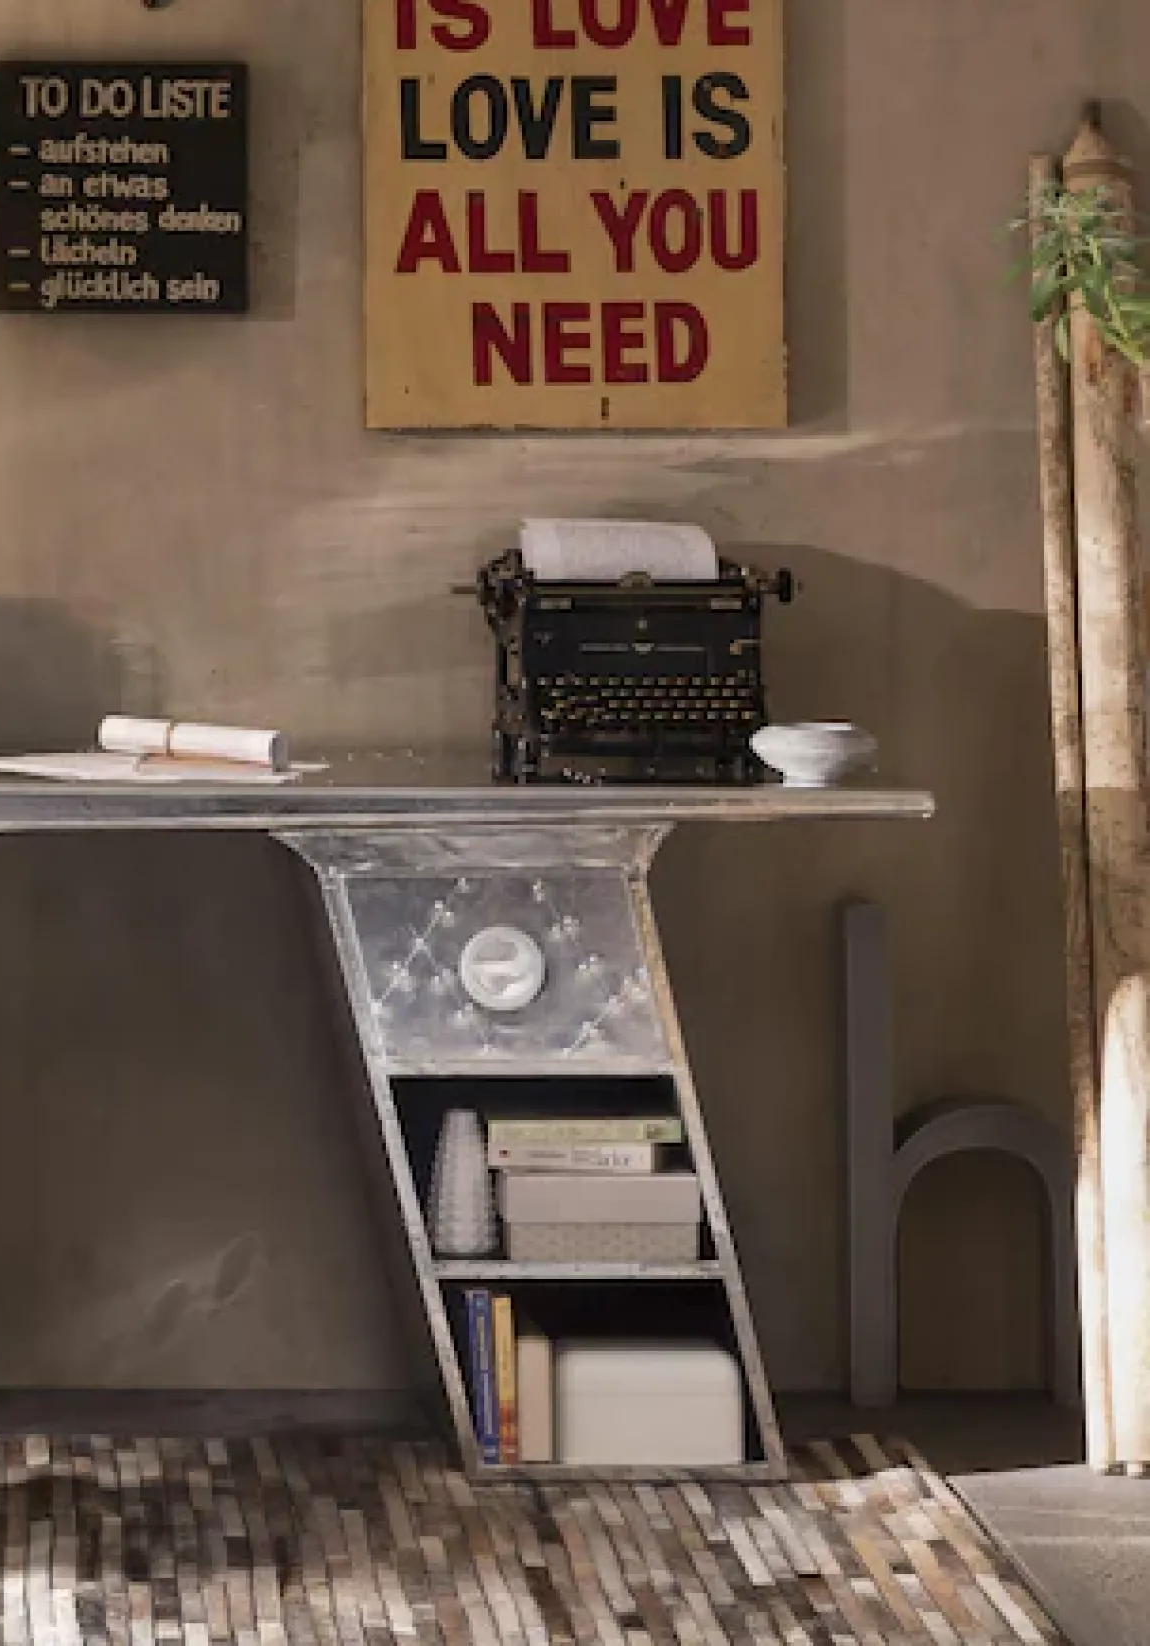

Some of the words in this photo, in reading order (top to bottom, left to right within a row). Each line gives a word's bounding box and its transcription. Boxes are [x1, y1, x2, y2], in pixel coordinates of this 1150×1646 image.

[395, 0, 492, 52] IS
[532, 0, 753, 50] LOVE
[19, 75, 69, 118] TO
[80, 77, 135, 118] DO
[142, 75, 232, 118] LISTE
[399, 73, 621, 160] LOVE
[660, 72, 752, 160] IS
[38, 132, 169, 164] aufstehen
[38, 173, 74, 198] an
[82, 171, 170, 198] etwas
[394, 188, 572, 273] ALL
[589, 188, 761, 273] YOU
[40, 270, 160, 308] glücklich
[165, 271, 221, 302] sein
[471, 301, 711, 386] NEED
